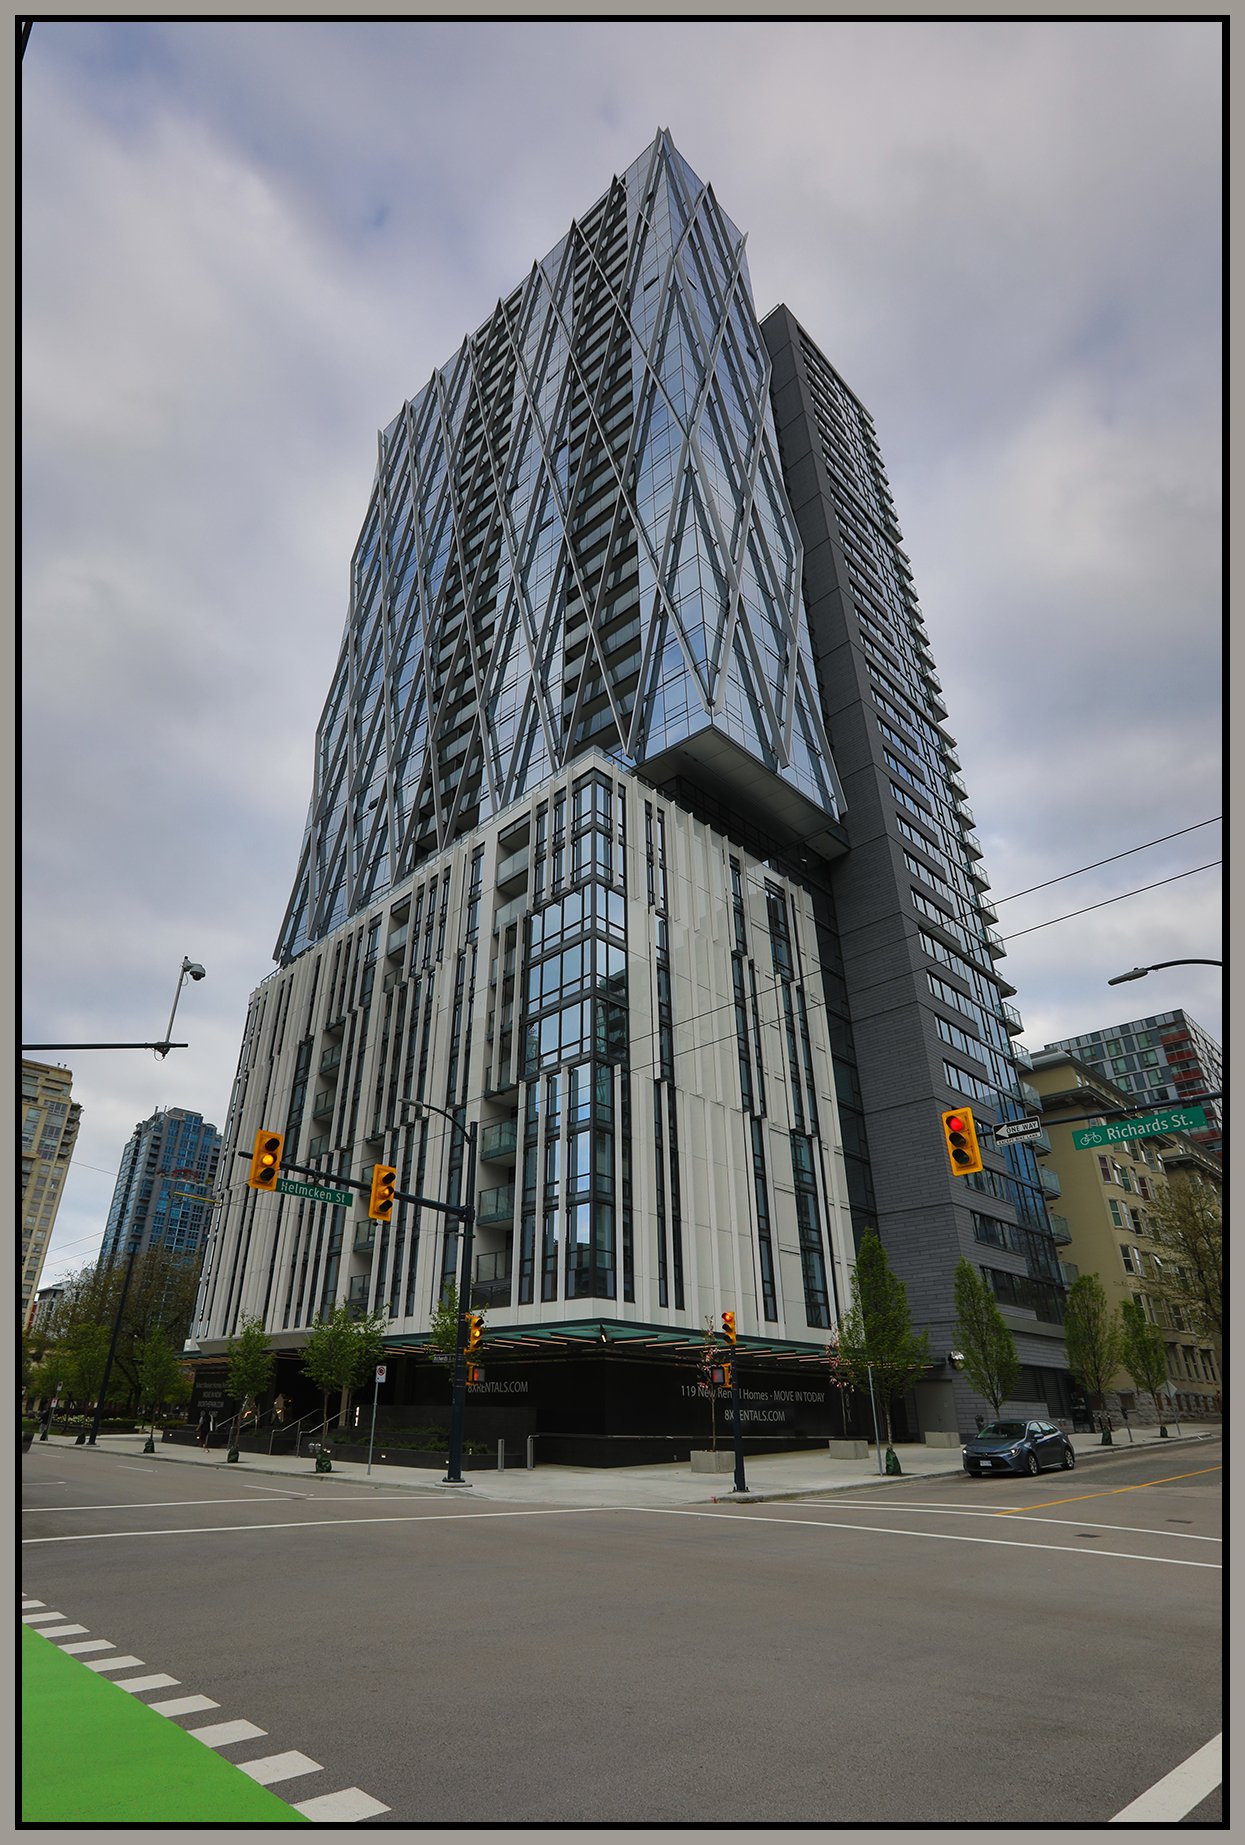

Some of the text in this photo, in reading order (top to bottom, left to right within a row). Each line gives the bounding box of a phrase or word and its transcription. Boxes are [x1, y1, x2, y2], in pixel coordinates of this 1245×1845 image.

[1006, 1121, 1037, 1134] ONE WAY
[1106, 1114, 1194, 1140] Richards St.
[281, 1181, 346, 1203] Helmcken St
[681, 1385, 696, 1397] 119
[697, 1386, 716, 1398] New
[717, 1388, 742, 1399] Renl
[743, 1389, 769, 1400] Homes
[773, 1390, 795, 1402] MOVE
[795, 1391, 803, 1401] IN
[803, 1391, 825, 1402] TODAY
[724, 1409, 786, 1422] 8XENTALS.COM
